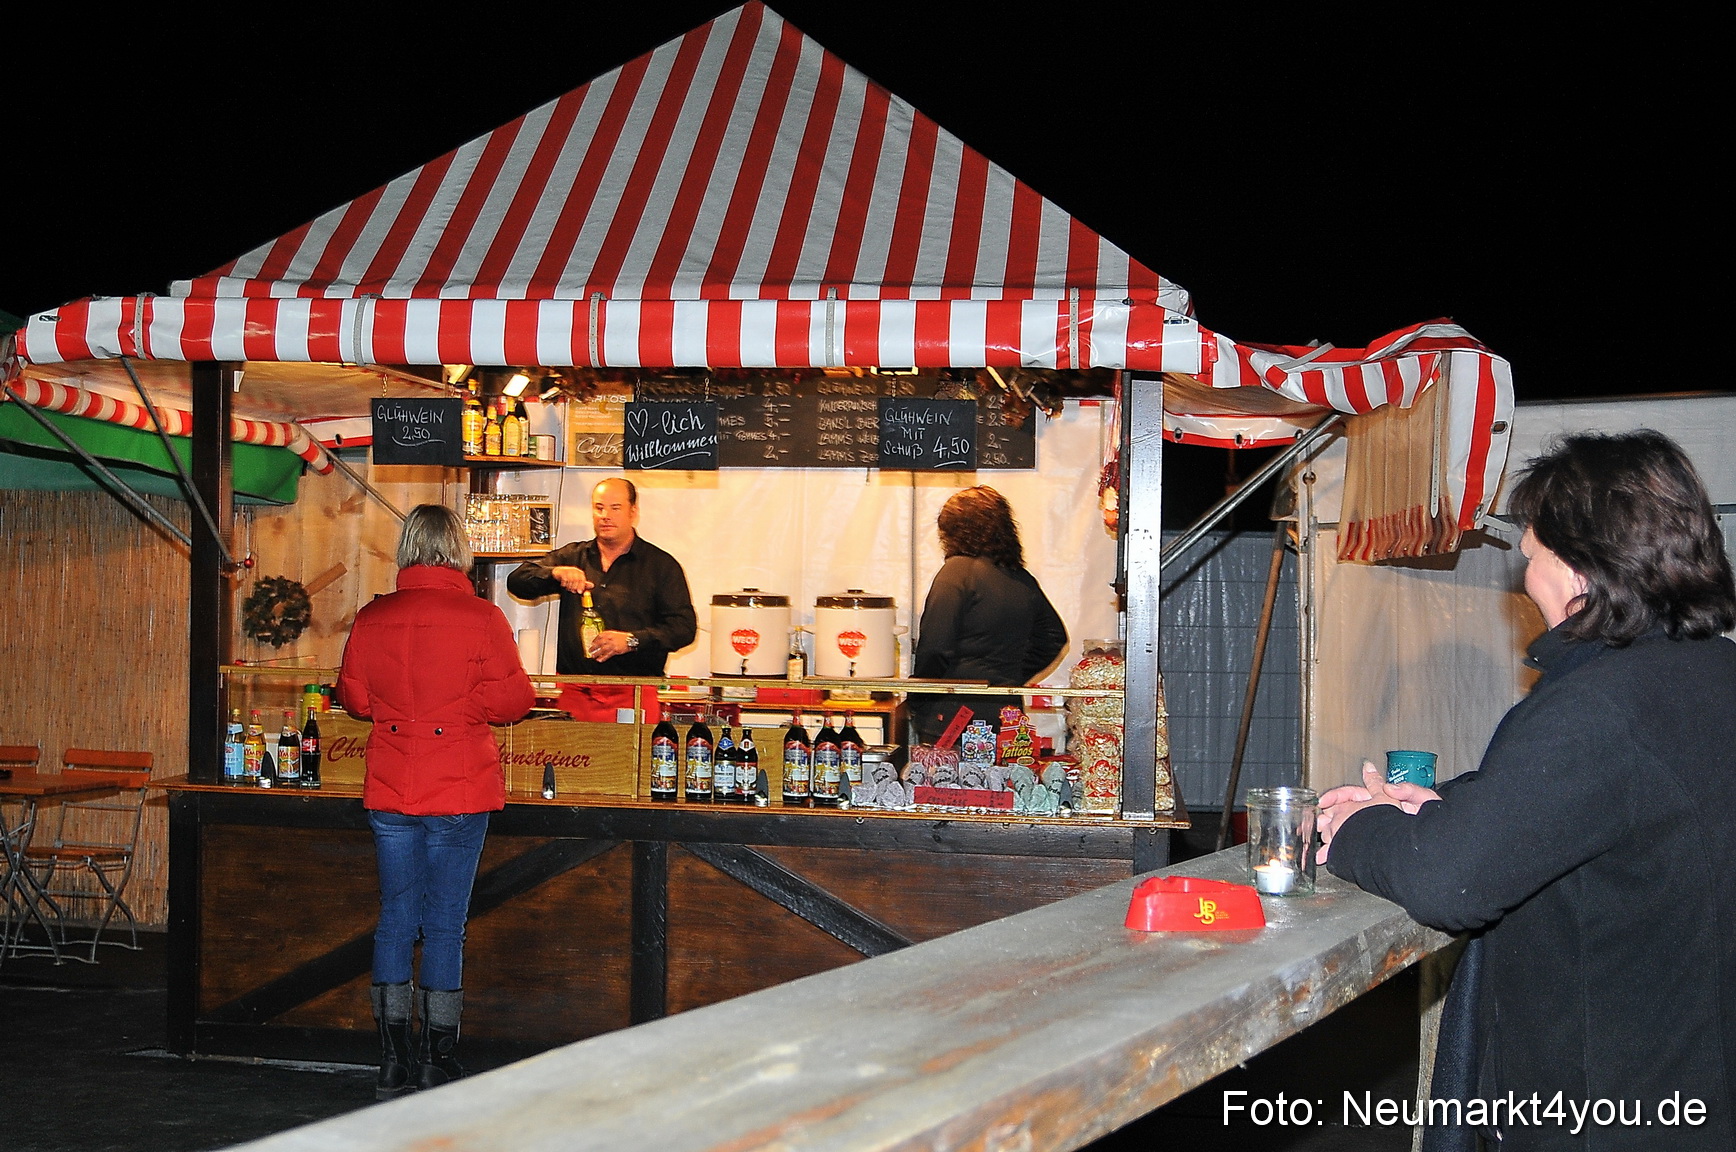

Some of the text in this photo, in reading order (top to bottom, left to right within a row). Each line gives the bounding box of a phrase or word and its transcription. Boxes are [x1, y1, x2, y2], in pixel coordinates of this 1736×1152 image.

[377, 404, 445, 424] GLÜHWEIN
[885, 406, 953, 425] GLÜHWEIN
[402, 426, 430, 440] 2,50
[900, 426, 926, 440] MIT
[625, 434, 720, 464] Willkommen
[933, 435, 970, 459] 4,50
[732, 635, 758, 644] WECK
[1002, 747, 1034, 758] Tattoos
